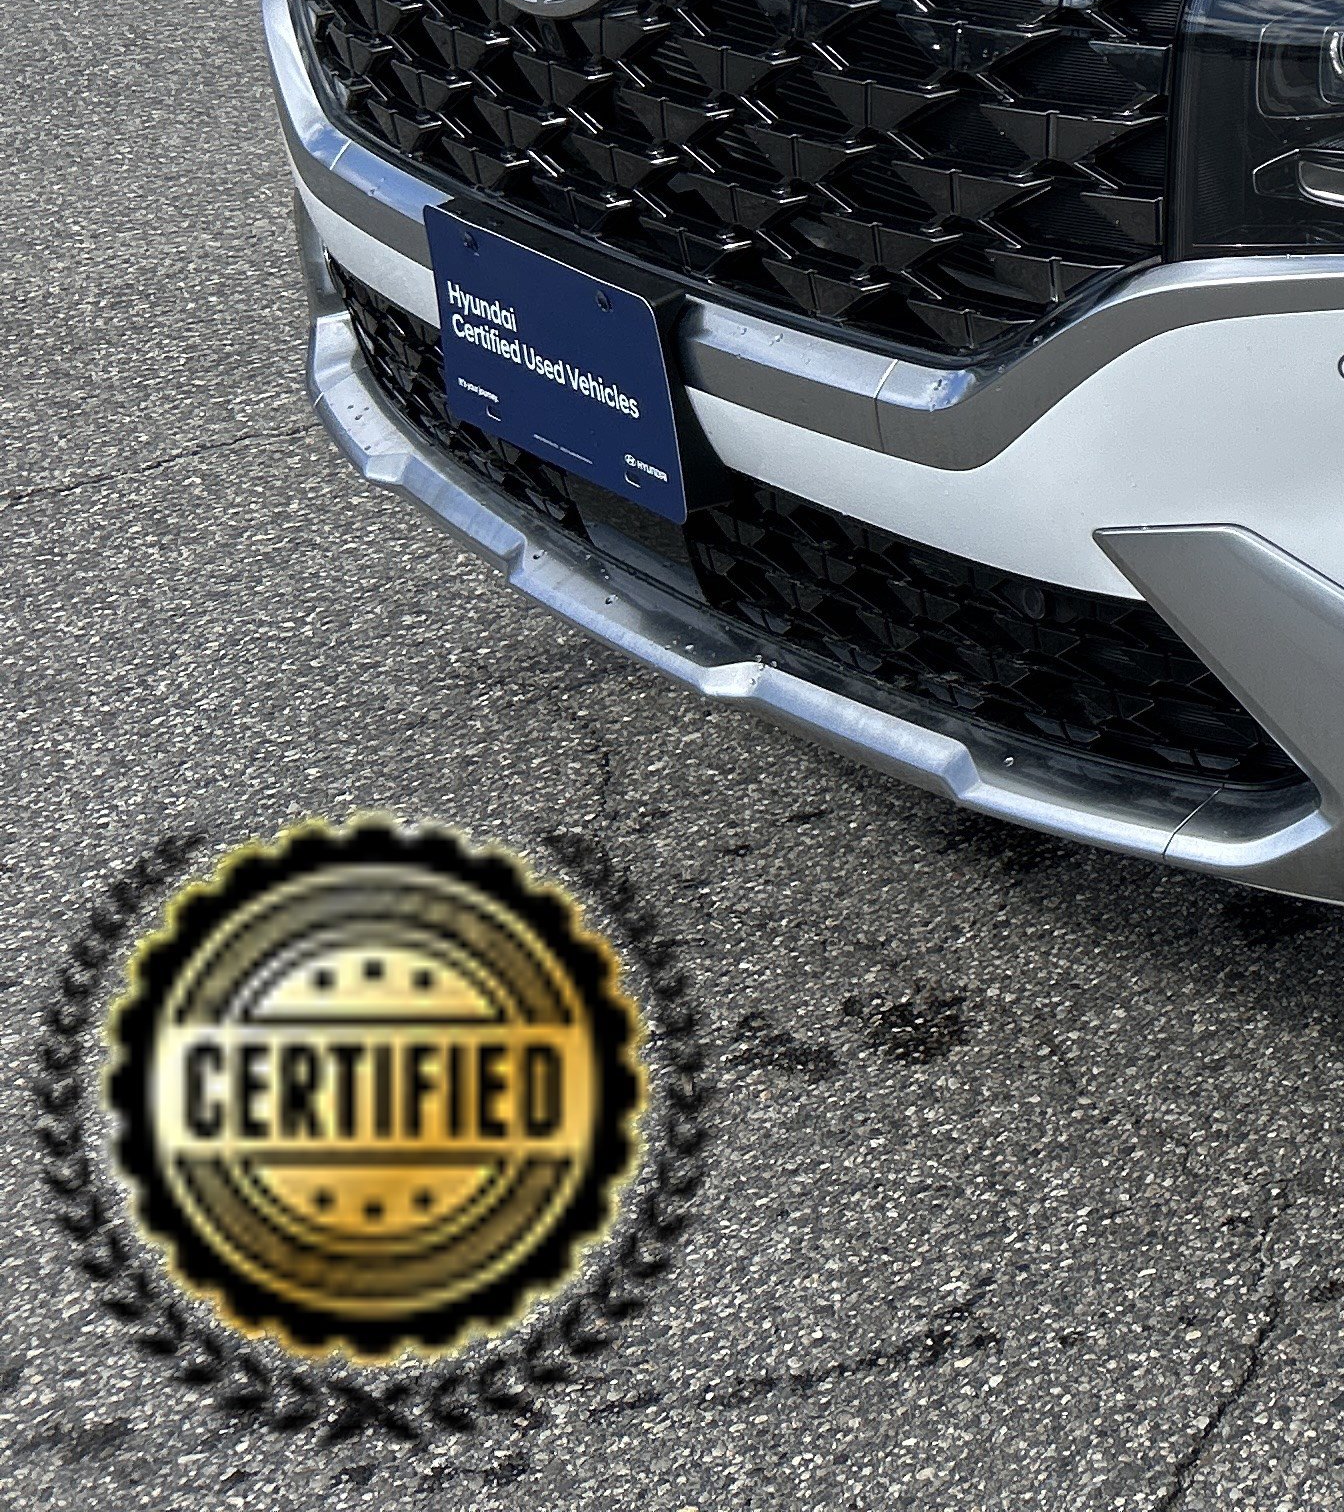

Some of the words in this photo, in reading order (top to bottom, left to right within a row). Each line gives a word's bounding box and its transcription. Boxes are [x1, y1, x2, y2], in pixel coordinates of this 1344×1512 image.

[447, 280, 518, 333] Hyundai
[451, 313, 522, 365] Certified
[522, 343, 566, 385] Used
[565, 364, 640, 419] Vehicles
